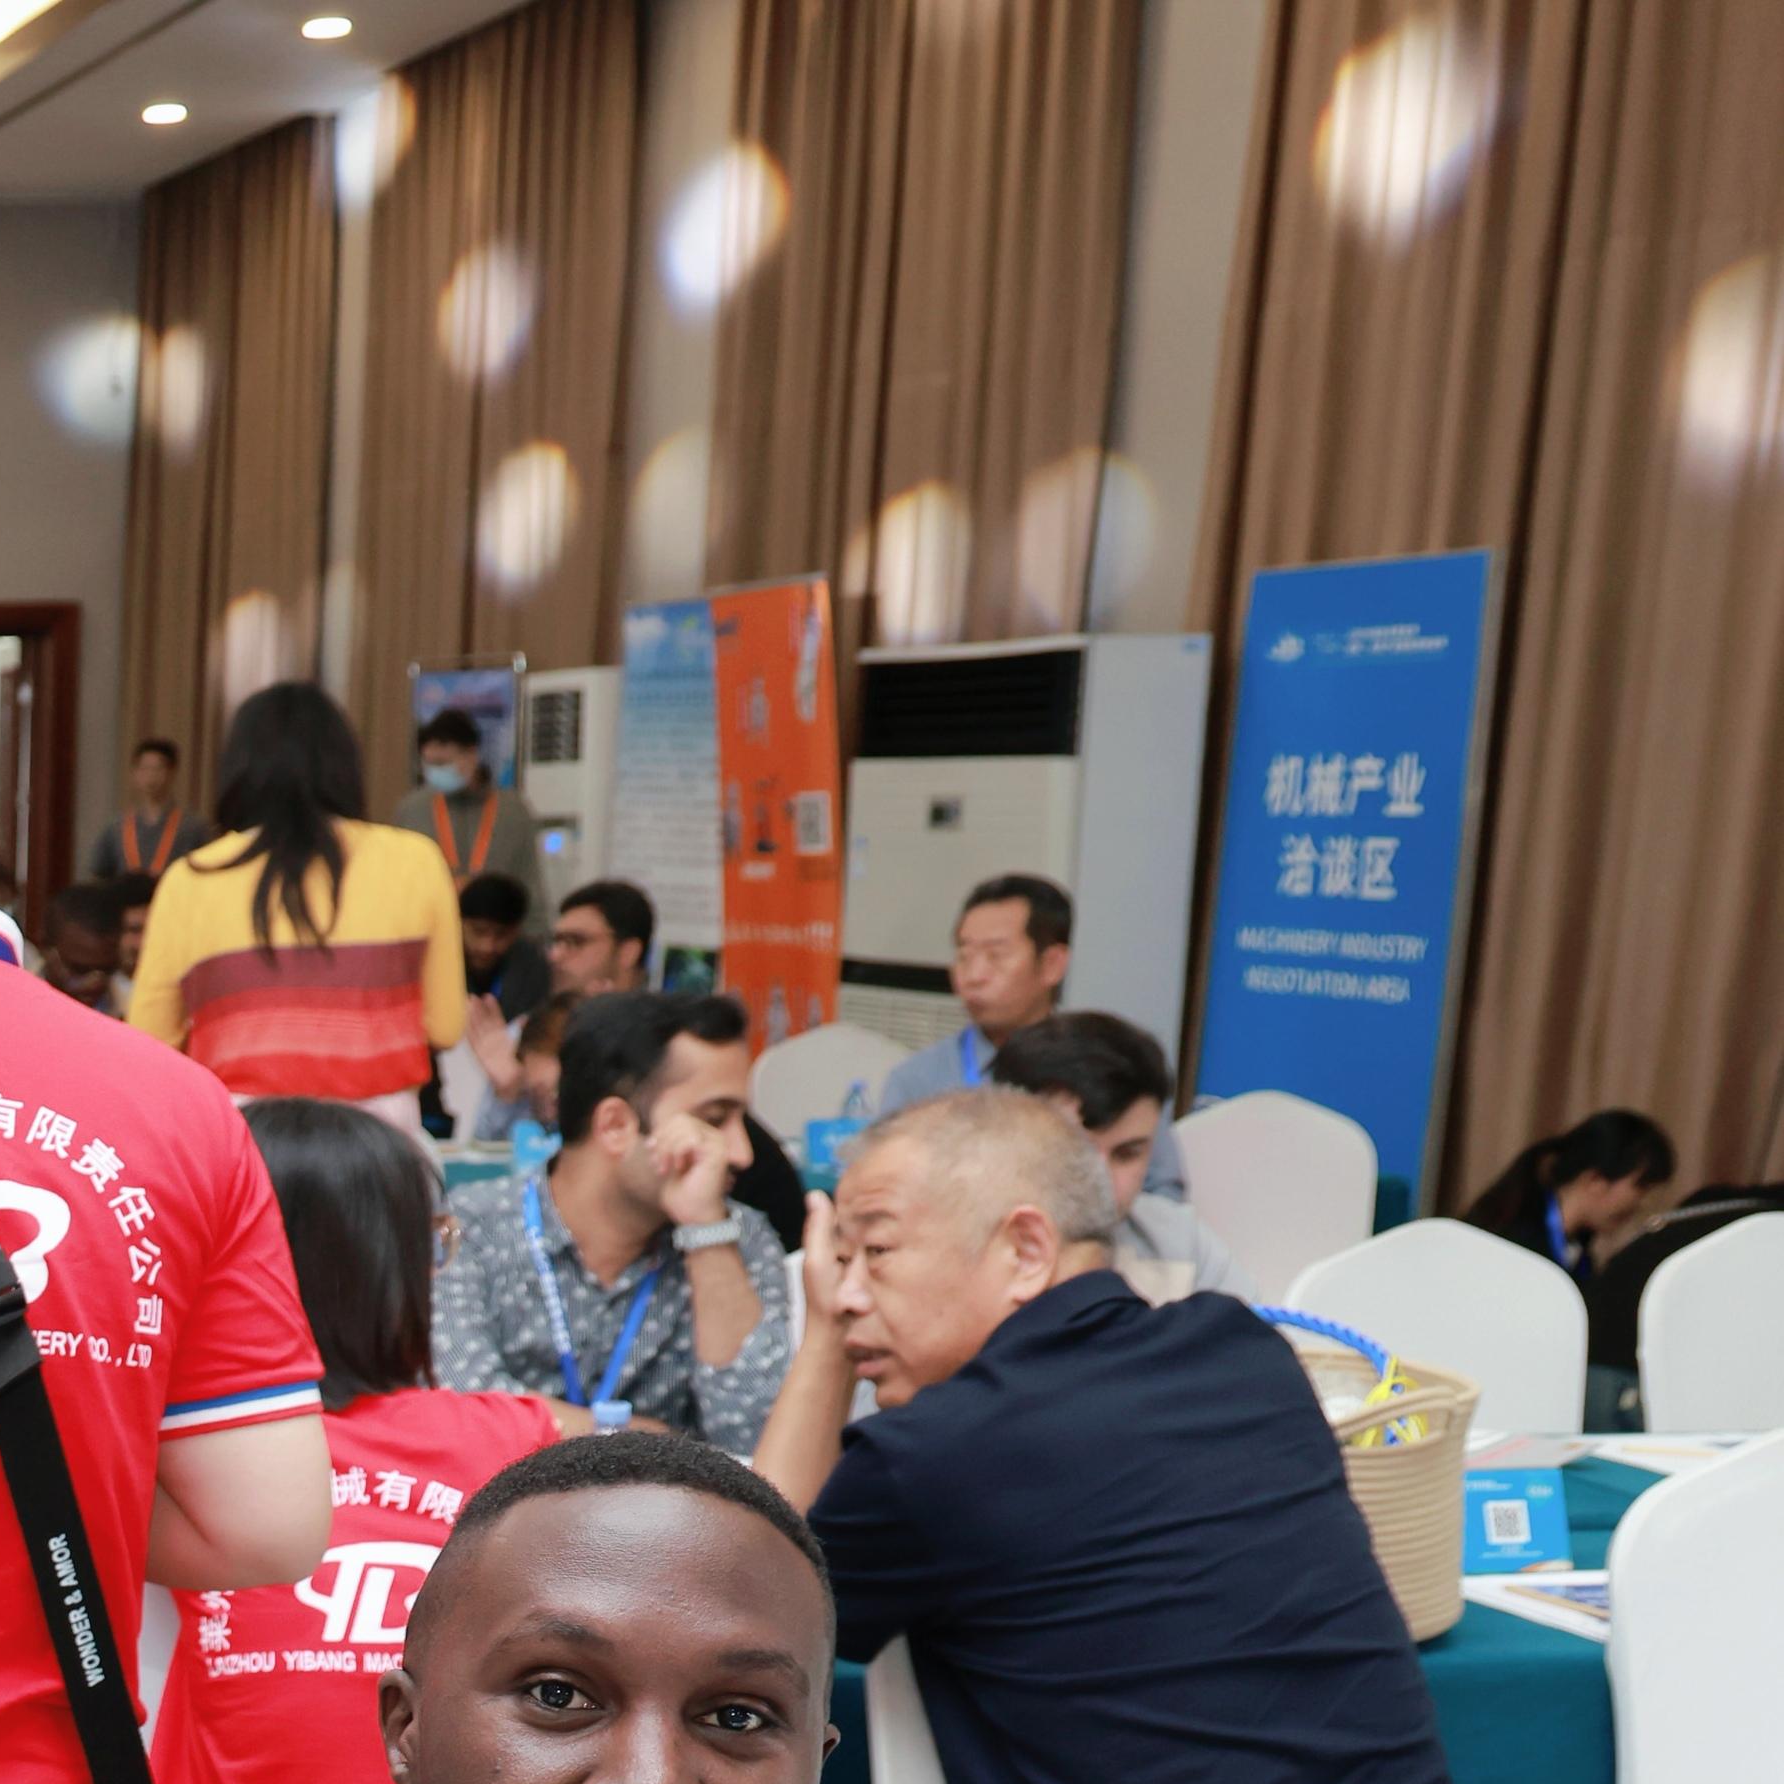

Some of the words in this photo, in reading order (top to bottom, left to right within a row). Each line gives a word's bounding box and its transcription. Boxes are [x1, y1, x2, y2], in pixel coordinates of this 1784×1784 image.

[1263, 752, 1426, 818] 机械产业
[1276, 834, 1400, 901] 洽谈区
[1339, 932, 1428, 962] INDUSTRY
[48, 1533, 79, 1589] AMOR
[63, 1590, 79, 1604] &
[68, 1605, 106, 1688] WONDER
[282, 1650, 357, 1673] YIBANG
